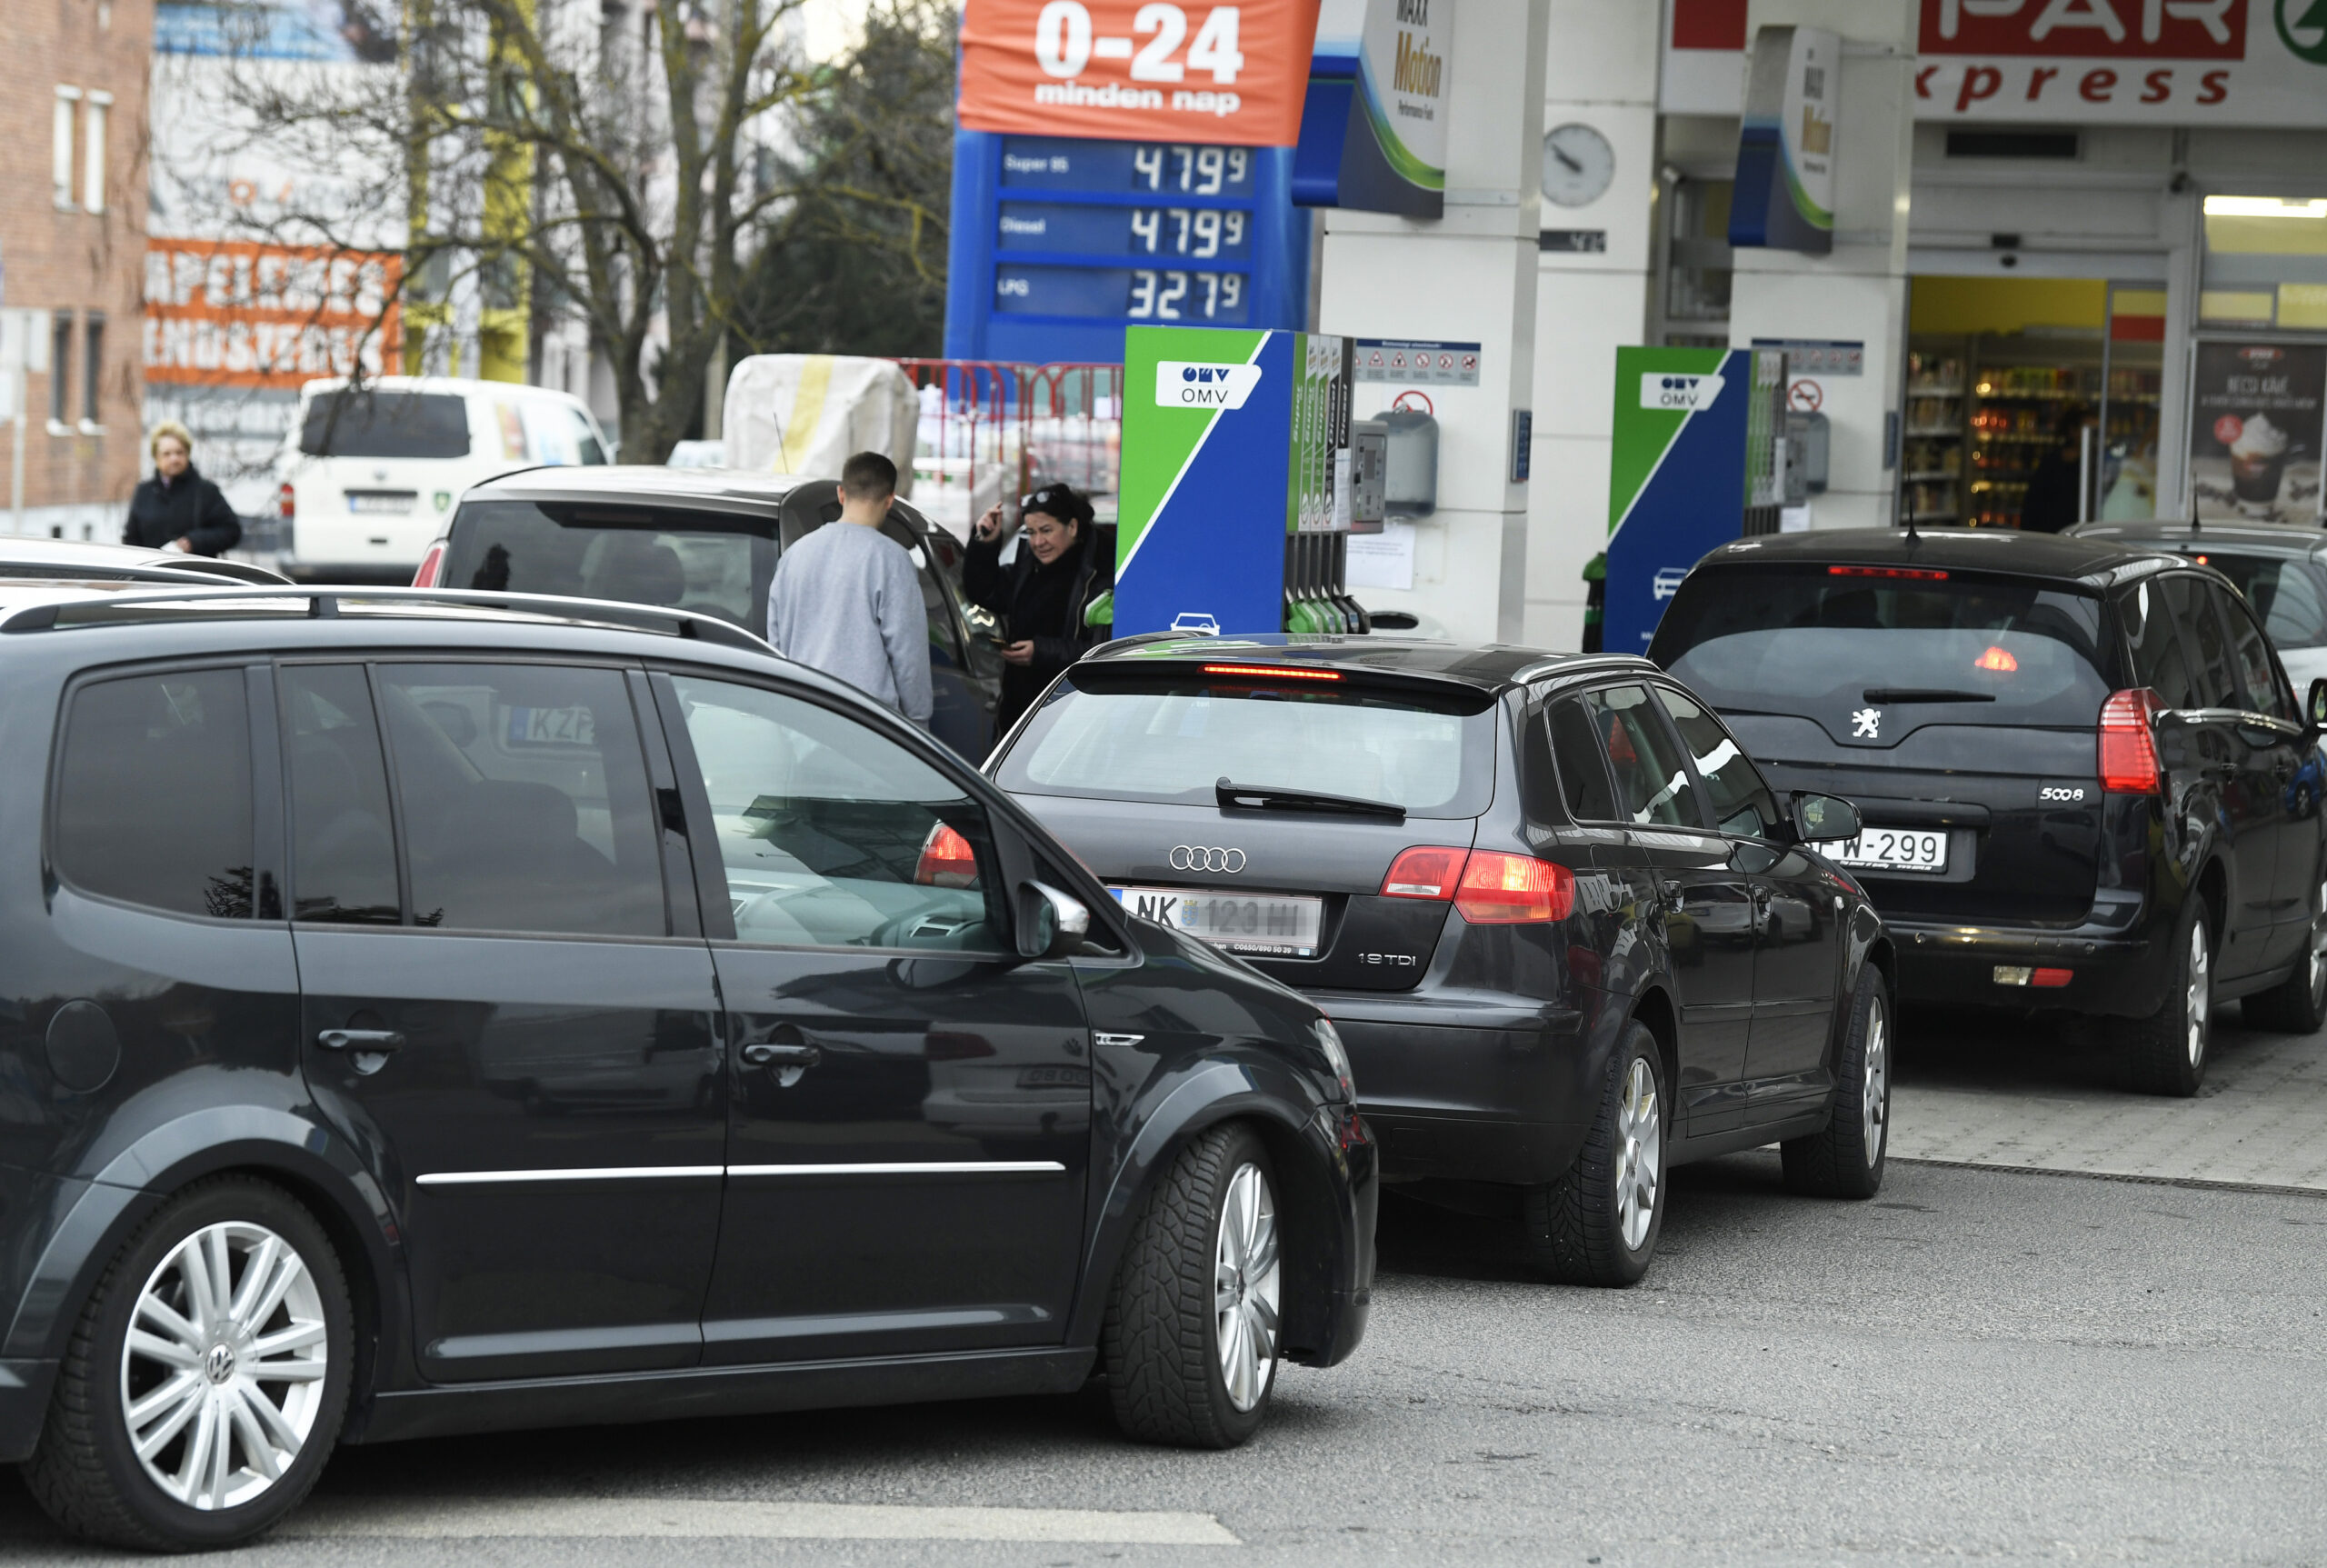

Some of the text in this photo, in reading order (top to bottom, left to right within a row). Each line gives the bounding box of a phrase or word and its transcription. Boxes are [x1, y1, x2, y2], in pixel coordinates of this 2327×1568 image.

[1393, 30, 1442, 98] Motion
[1034, 80, 1242, 117] minden nap
[1004, 153, 1048, 174] Super
[1000, 216, 1046, 235] Diesel
[997, 279, 1030, 297] LPG
[1182, 388, 1228, 404] OMV
[1661, 393, 1699, 406] OMV
[2040, 787, 2084, 802] 5008
[1137, 895, 1177, 929] NK
